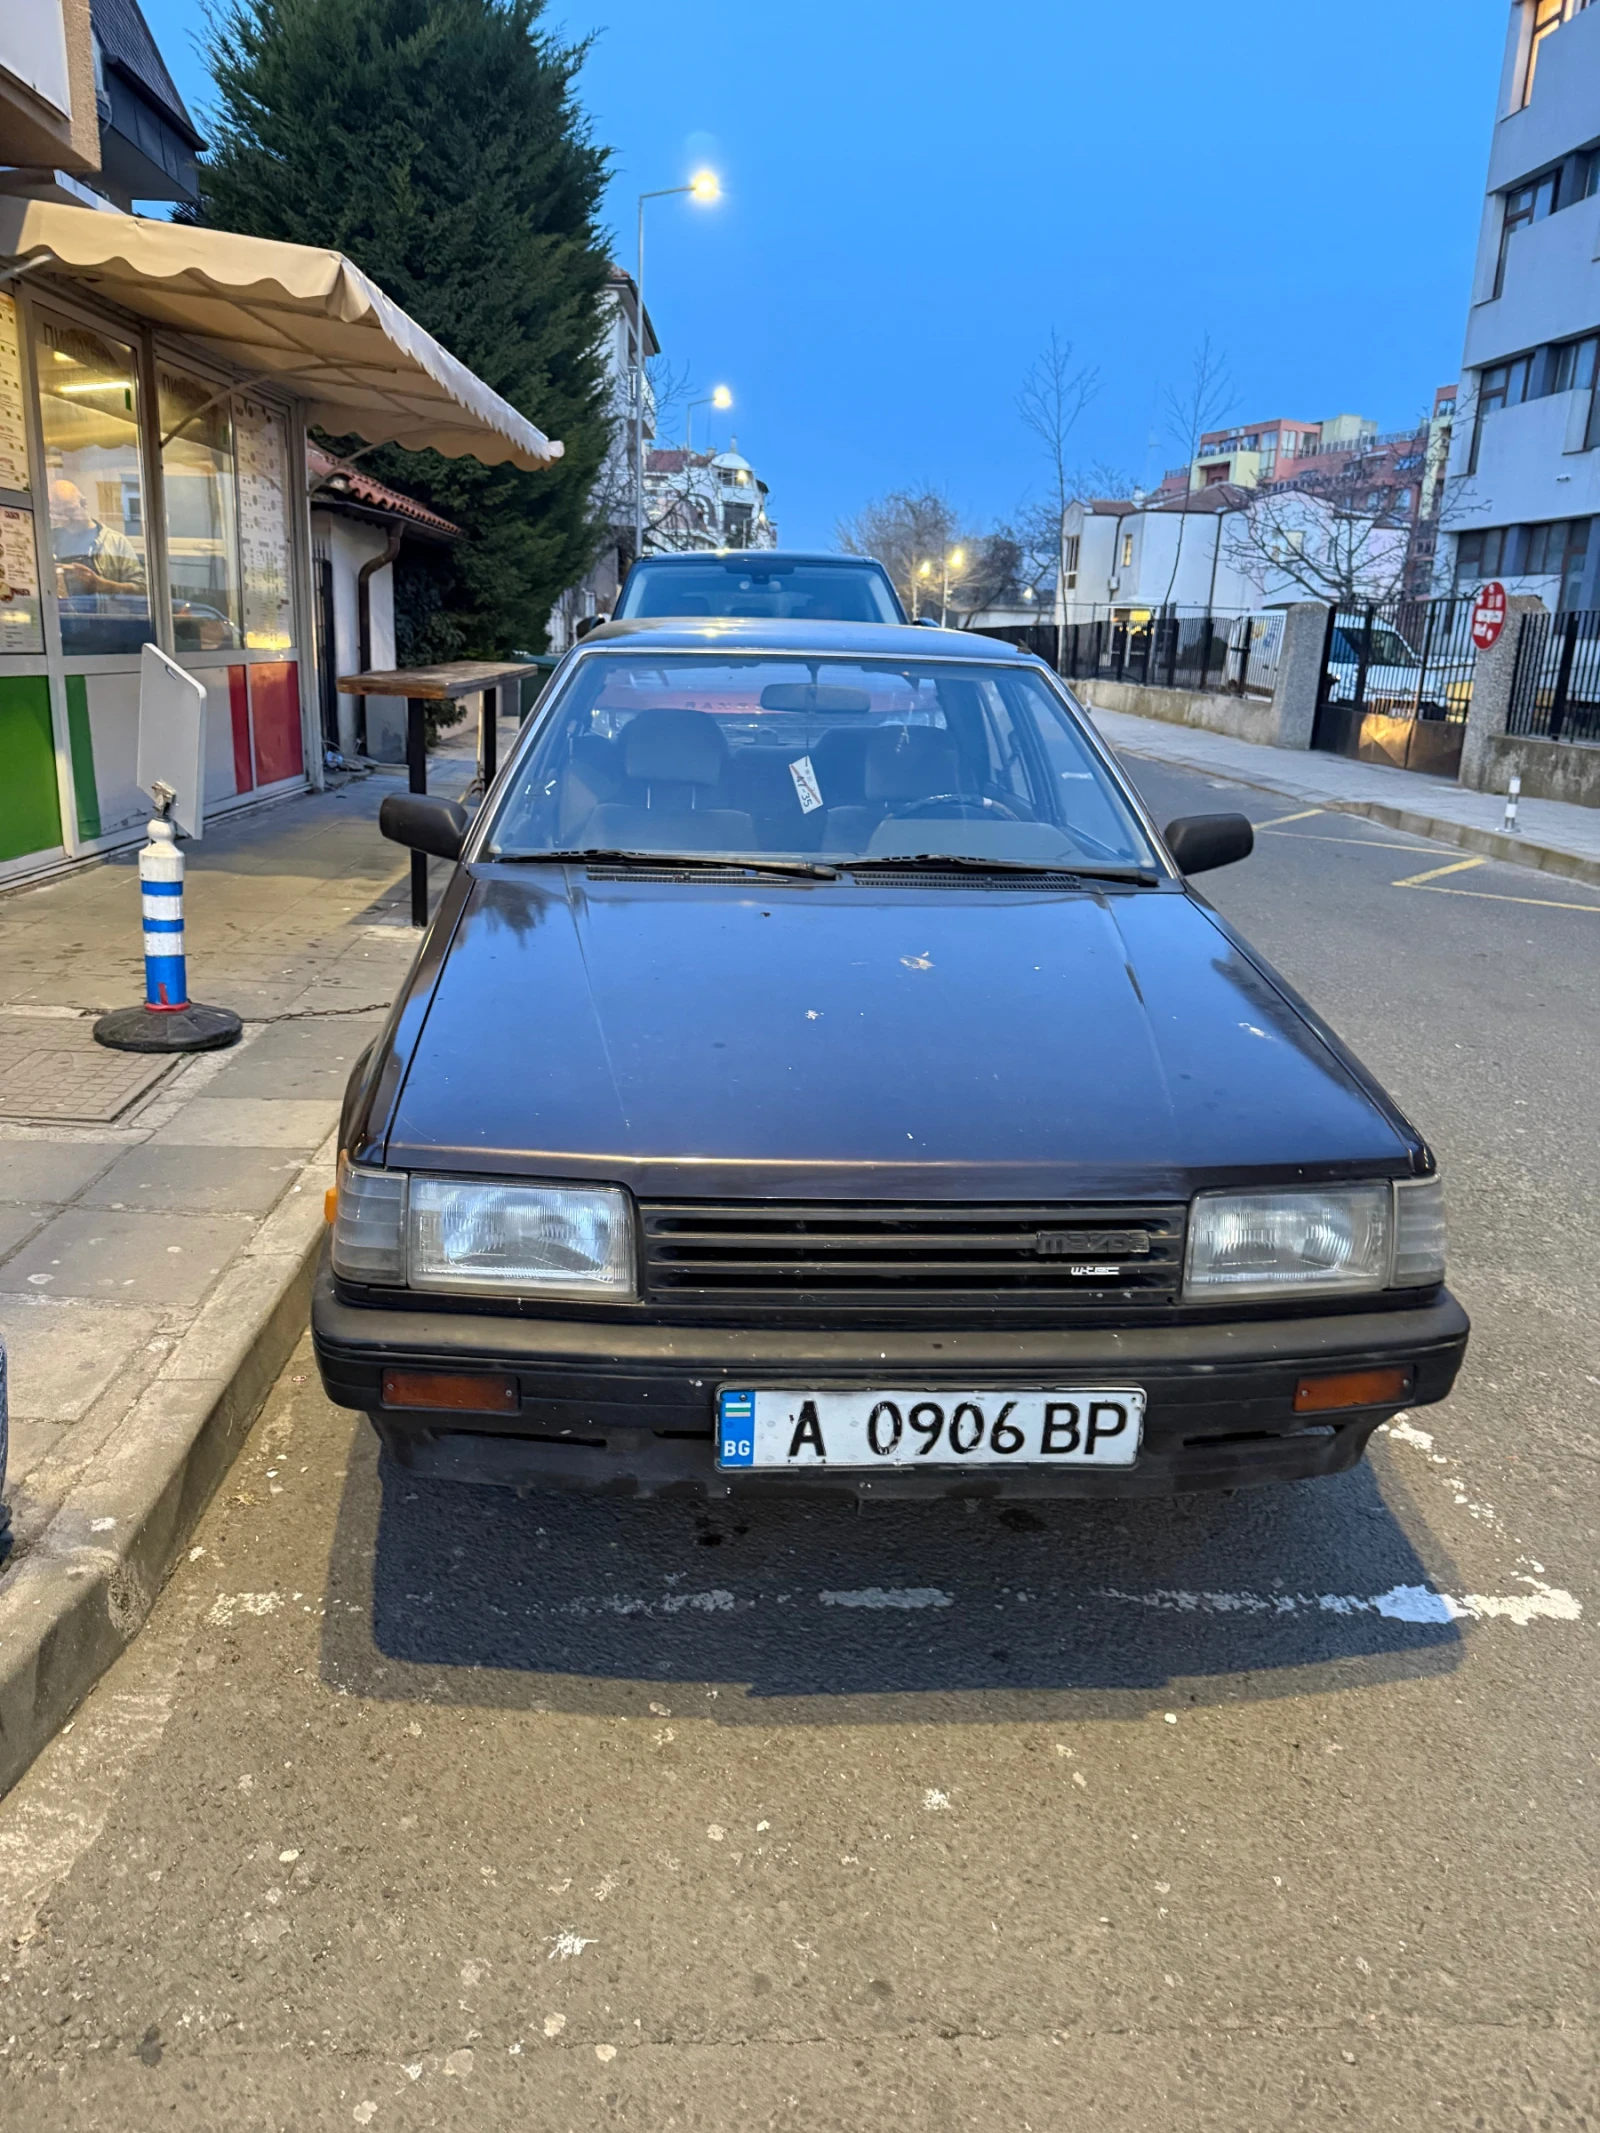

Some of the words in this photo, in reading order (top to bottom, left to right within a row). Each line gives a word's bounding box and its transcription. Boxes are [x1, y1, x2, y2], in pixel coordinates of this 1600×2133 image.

[723, 1439, 751, 1457] BG
[787, 1400, 827, 1458] A
[867, 1400, 1026, 1456] 0906
[1039, 1402, 1128, 1455] BP
